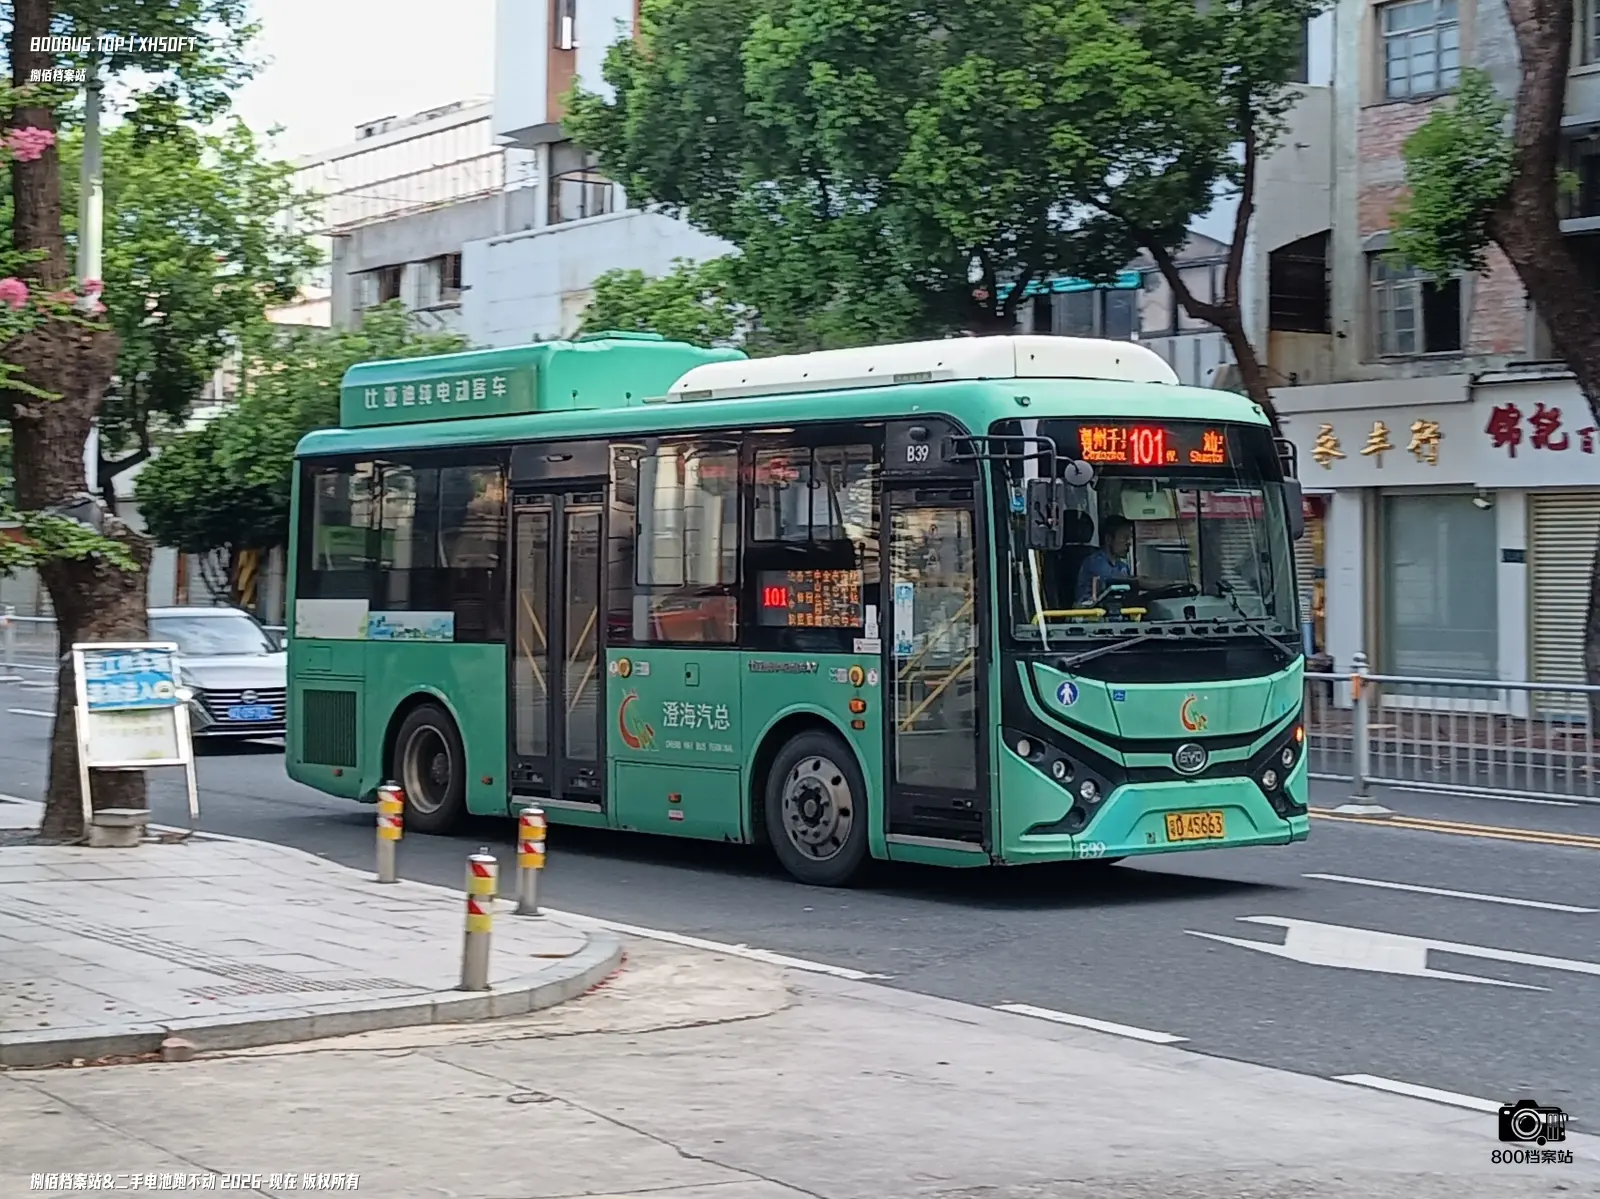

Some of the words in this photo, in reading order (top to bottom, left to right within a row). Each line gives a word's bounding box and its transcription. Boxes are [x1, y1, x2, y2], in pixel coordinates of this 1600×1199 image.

[907, 445, 928, 462] B39
[1130, 428, 1163, 465] 101
[763, 587, 787, 607] 101
[662, 701, 731, 731] 澄海汽总
[1180, 752, 1202, 764] BYD
